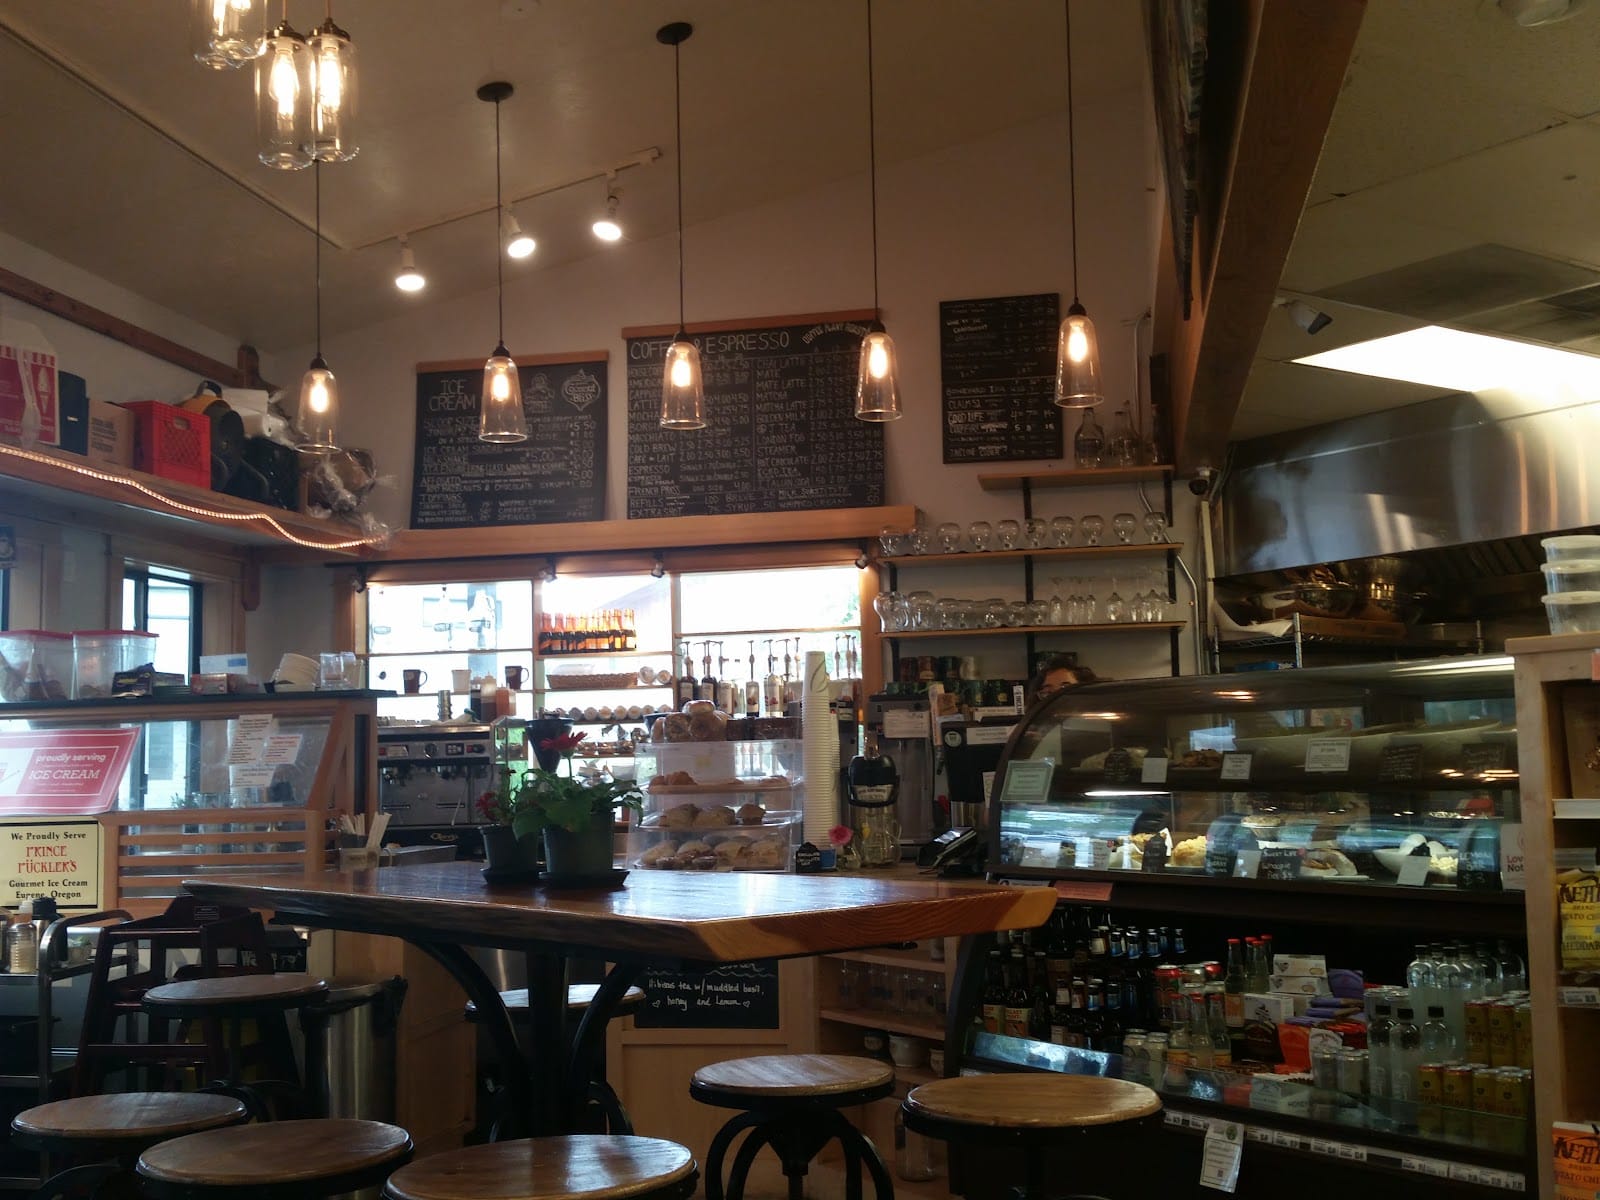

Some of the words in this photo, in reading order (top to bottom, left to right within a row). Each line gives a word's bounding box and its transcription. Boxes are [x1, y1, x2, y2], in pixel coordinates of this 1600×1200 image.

[630, 340, 674, 360] COFF
[705, 331, 789, 354] ESPRESSO
[440, 379, 467, 396] ICE
[428, 394, 476, 412] CREAM
[36, 752, 71, 764] proudly
[71, 752, 106, 763] serving
[28, 769, 50, 780] ICE
[53, 769, 101, 780] CREAM
[11, 832, 23, 840] We
[26, 832, 60, 841] Proudly
[63, 831, 86, 839] Serve
[26, 845, 68, 857] PRINCE
[1506, 856, 1524, 864] Lov
[9, 879, 45, 888] Gourmet
[48, 879, 60, 887] Ice
[62, 879, 88, 887] Cream
[50, 890, 82, 900] Oregon
[1560, 880, 1600, 903] KETT
[706, 982, 740, 993] muddled
[1554, 1137, 1600, 1164] KETT
